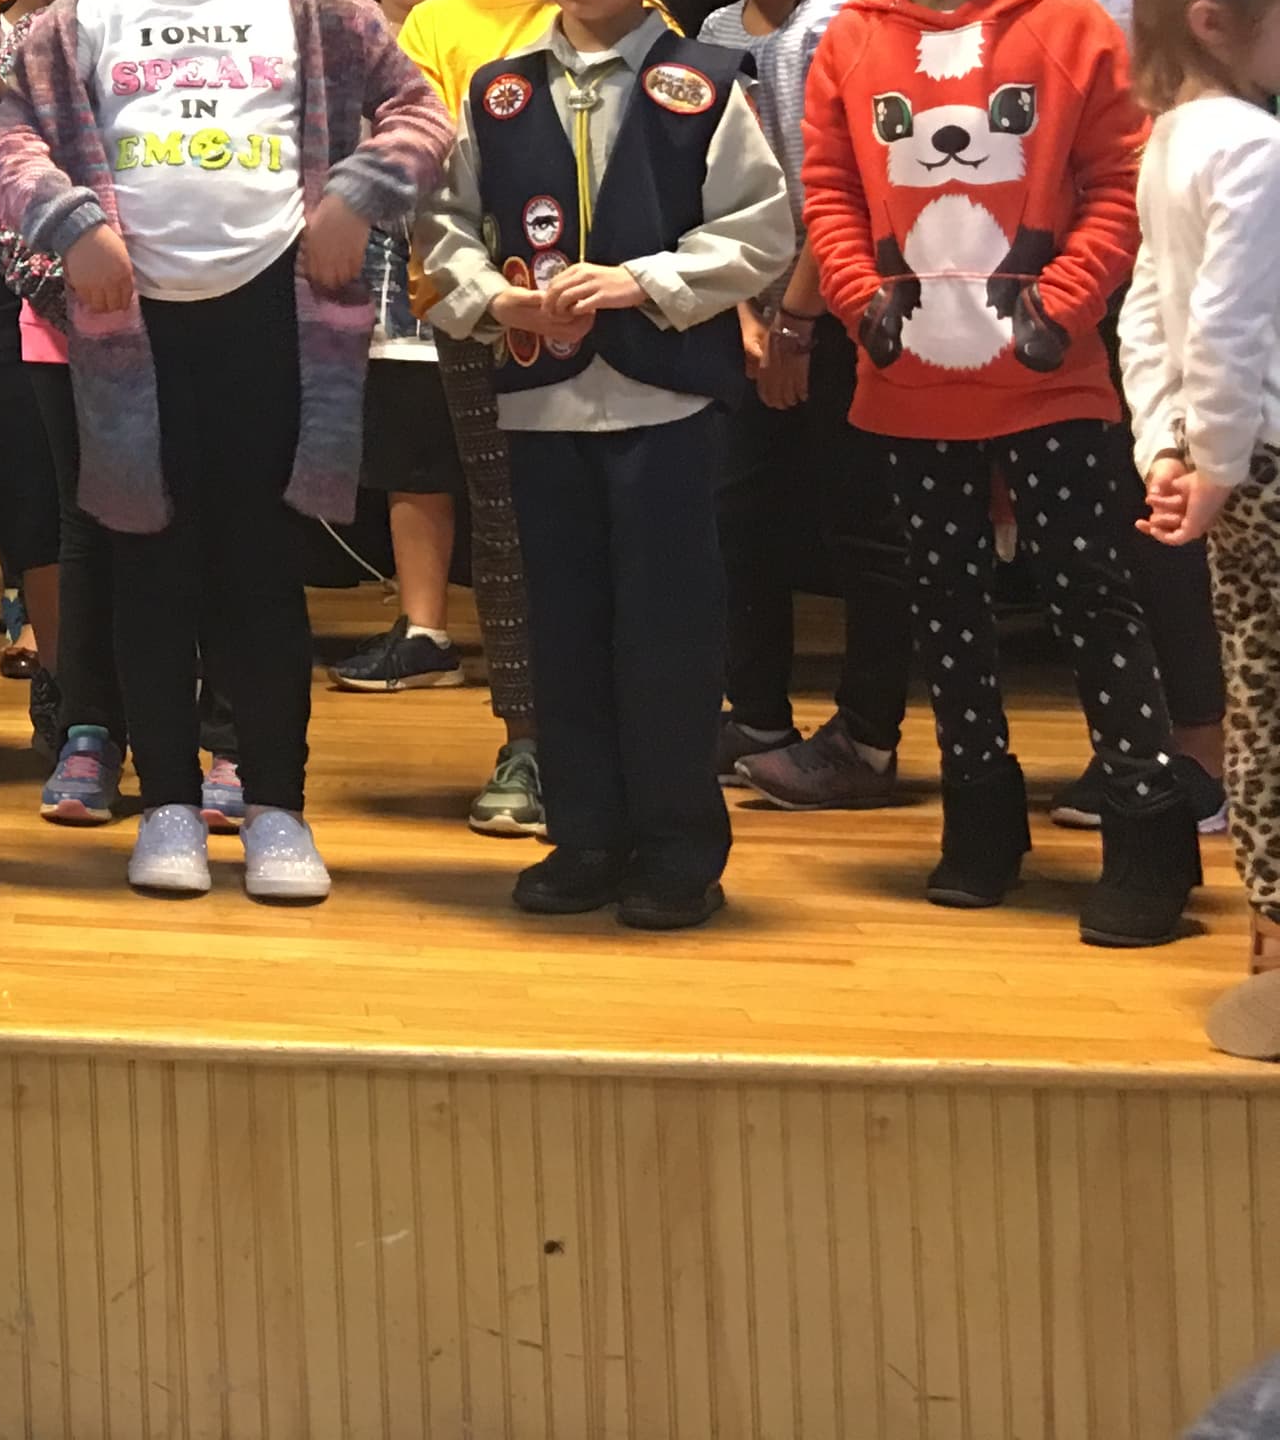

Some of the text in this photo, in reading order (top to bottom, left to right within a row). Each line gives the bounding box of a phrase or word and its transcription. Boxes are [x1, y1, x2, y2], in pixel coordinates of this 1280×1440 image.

[140, 24, 253, 47] I ONLY
[111, 55, 283, 97] SPEAK
[180, 99, 219, 119] IN
[115, 128, 283, 172] EMOJI
